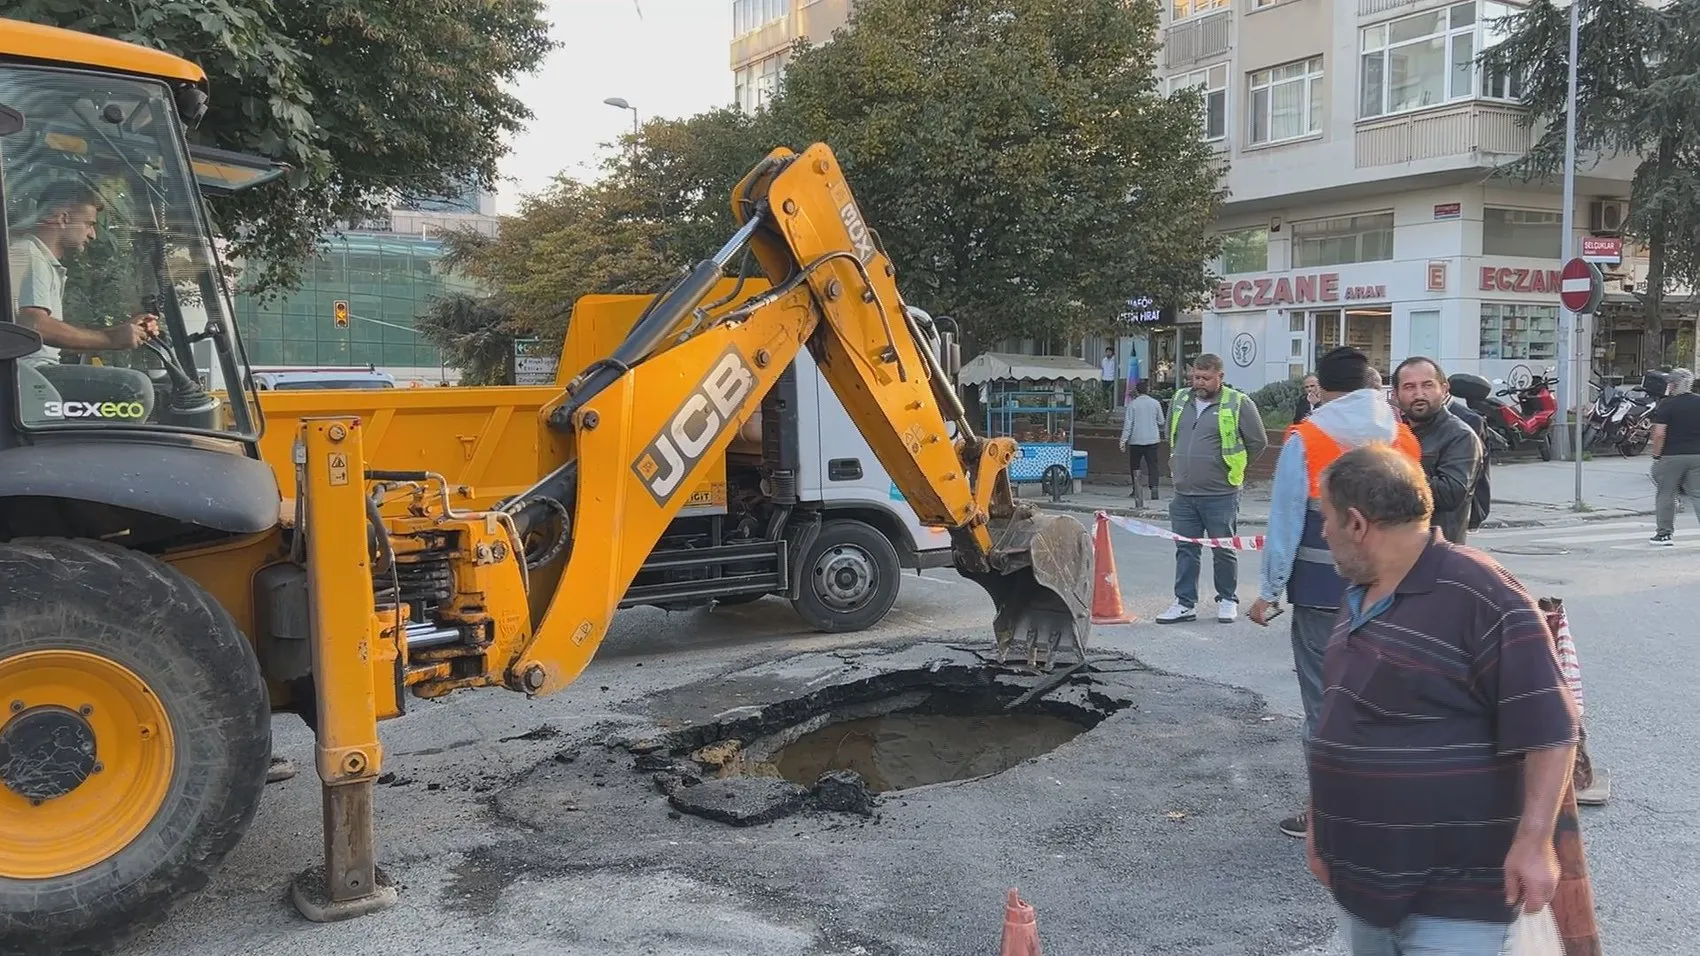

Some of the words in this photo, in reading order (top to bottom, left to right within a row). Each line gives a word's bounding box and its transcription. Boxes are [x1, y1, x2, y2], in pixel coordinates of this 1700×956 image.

[841, 203, 873, 260] 3CX
[1215, 273, 1340, 308] ECZANE
[1344, 285, 1386, 299] ARAN
[1431, 268, 1443, 287] E
[1479, 266, 1561, 293] ECZAN
[44, 401, 144, 418] 3CXeco
[651, 353, 753, 497] JCB
